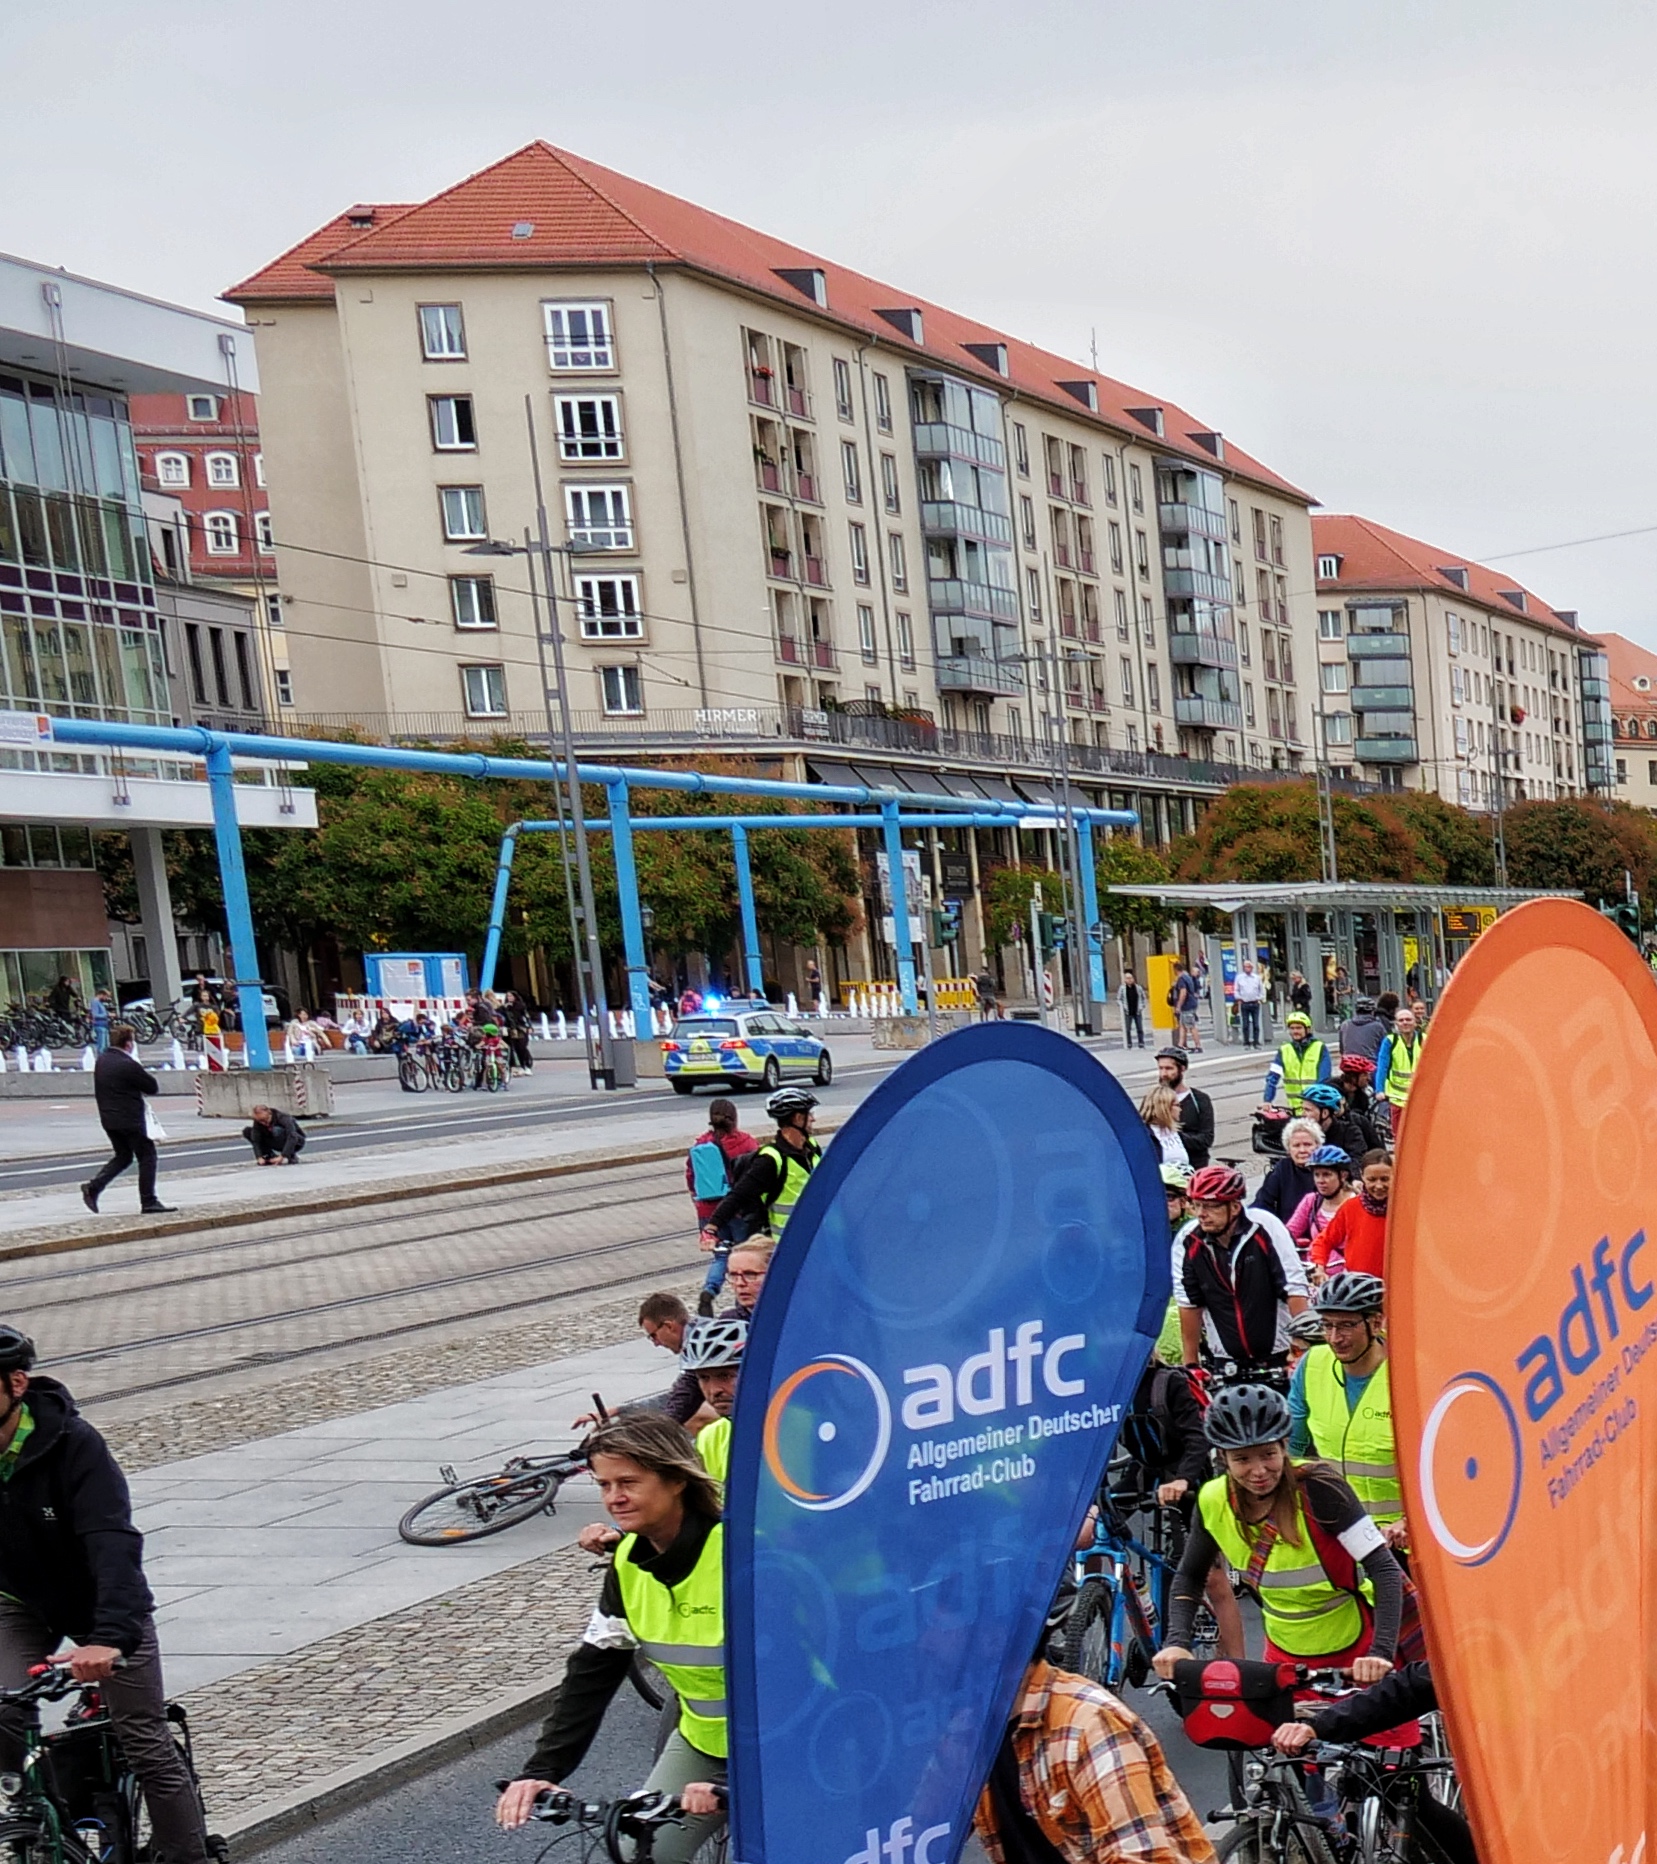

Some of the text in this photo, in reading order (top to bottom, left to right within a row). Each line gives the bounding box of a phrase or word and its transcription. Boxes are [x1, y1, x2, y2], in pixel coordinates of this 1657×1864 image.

[695, 709, 757, 723] HIRMER
[1515, 1227, 1655, 1423] adfc
[901, 1319, 1087, 1432] adfc
[1538, 1362, 1622, 1470] Allgemeiner
[905, 1400, 1121, 1471] Allgemeiner Deutscher
[1546, 1395, 1638, 1510] Fahrrad-Club
[908, 1454, 1037, 1507] Fahrrad-Club
[690, 1603, 717, 1616] adfc
